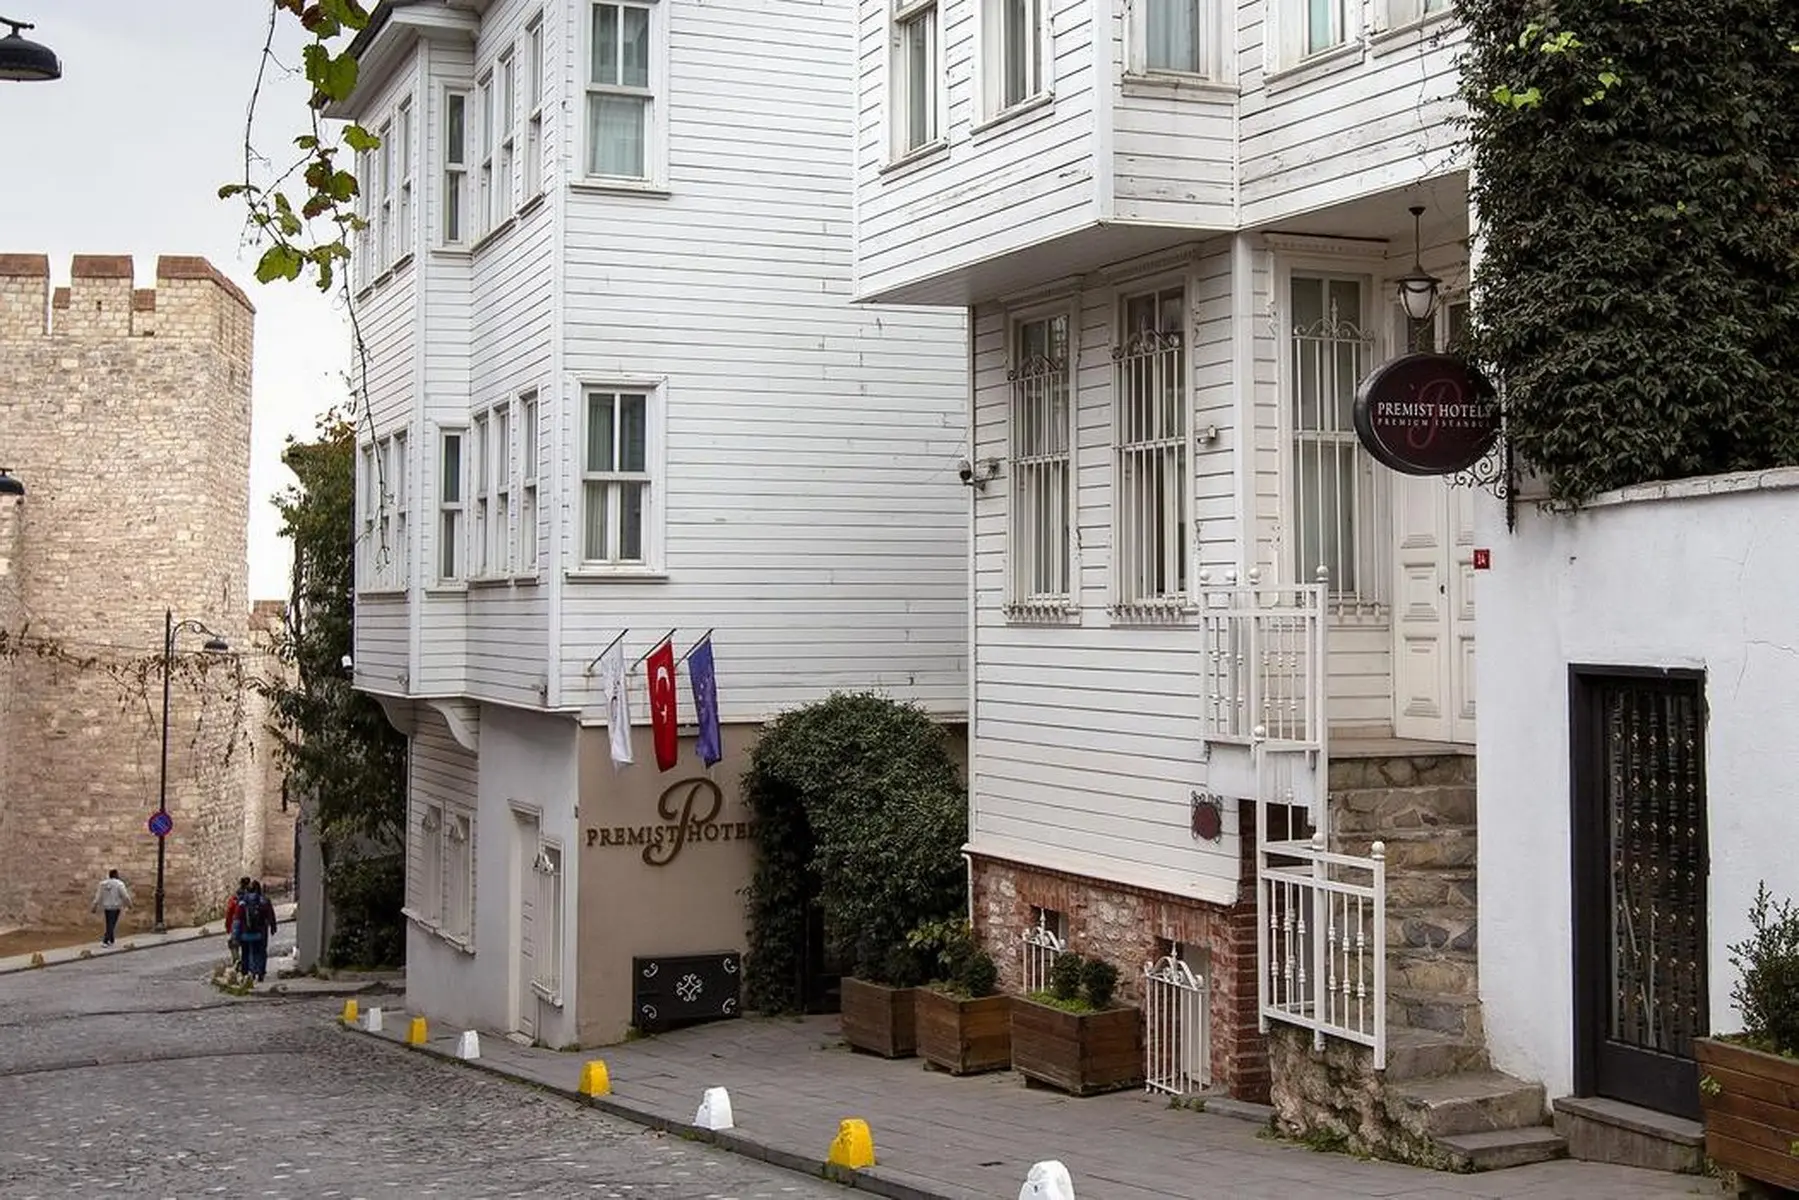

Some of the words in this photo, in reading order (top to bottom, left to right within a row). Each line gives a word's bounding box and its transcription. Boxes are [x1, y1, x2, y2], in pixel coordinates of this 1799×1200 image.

[1377, 402, 1435, 417] PREMIST
[1377, 418, 1429, 427] PREMIUM
[642, 777, 723, 867] P
[586, 825, 679, 847] PREMIST
